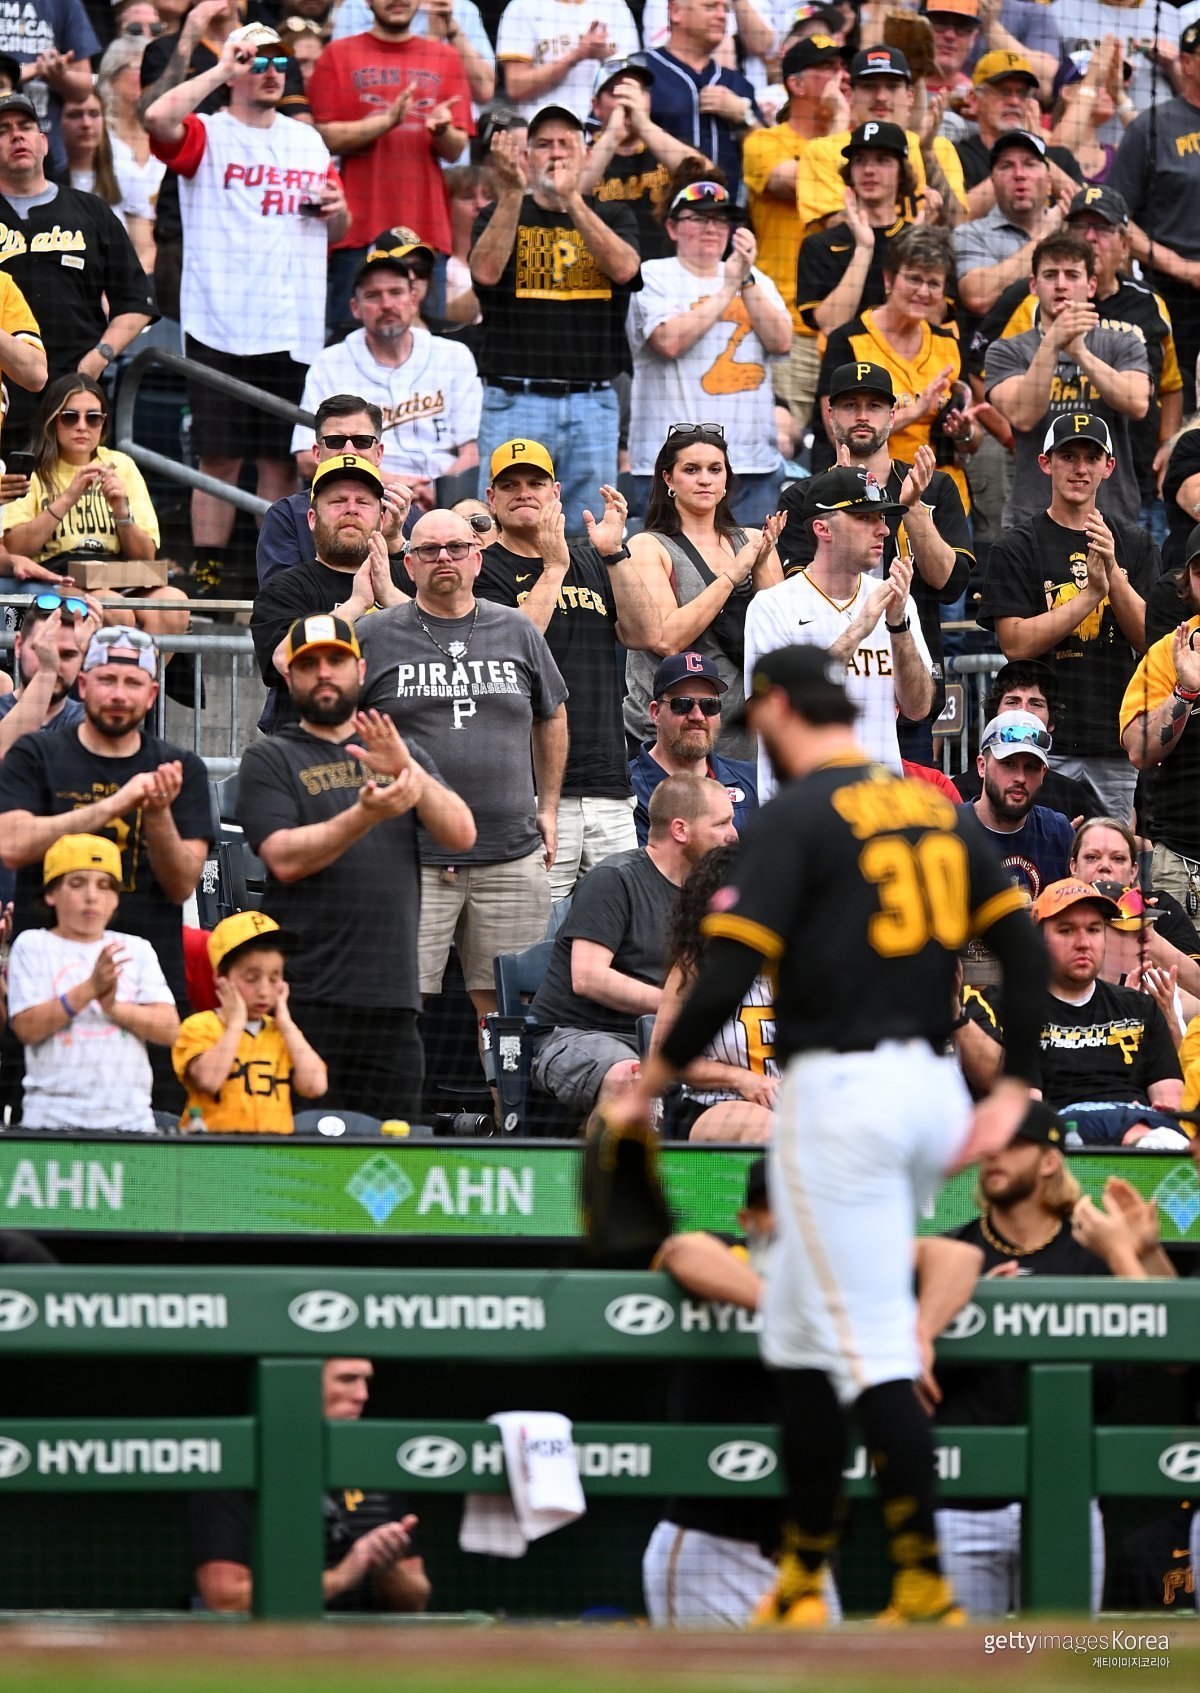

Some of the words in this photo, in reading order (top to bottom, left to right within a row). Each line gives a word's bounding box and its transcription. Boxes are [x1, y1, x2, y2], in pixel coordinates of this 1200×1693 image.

[22, 3, 37, 19] A
[1006, 53, 1018, 66] P
[864, 122, 879, 141] P
[1085, 188, 1103, 205] P
[553, 240, 577, 282] P
[857, 363, 871, 381] P
[1073, 414, 1089, 432] P
[512, 443, 526, 459] P
[343, 456, 356, 468] P
[685, 652, 703, 672] C
[398, 661, 518, 687] PIRATES
[397, 684, 469, 698] PITTSBURGH
[471, 682, 522, 696] BASEBALL
[453, 698, 477, 730] P
[858, 833, 970, 958] 30
[251, 913, 265, 934] P
[7, 1160, 124, 1210] AHN
[416, 1166, 534, 1216] AHN
[45, 1293, 228, 1328] HYUNDAI
[364, 1294, 546, 1331] HYUNDAI
[992, 1302, 1168, 1338] HYUNDAI
[37, 1439, 222, 1474] HYUNDAI
